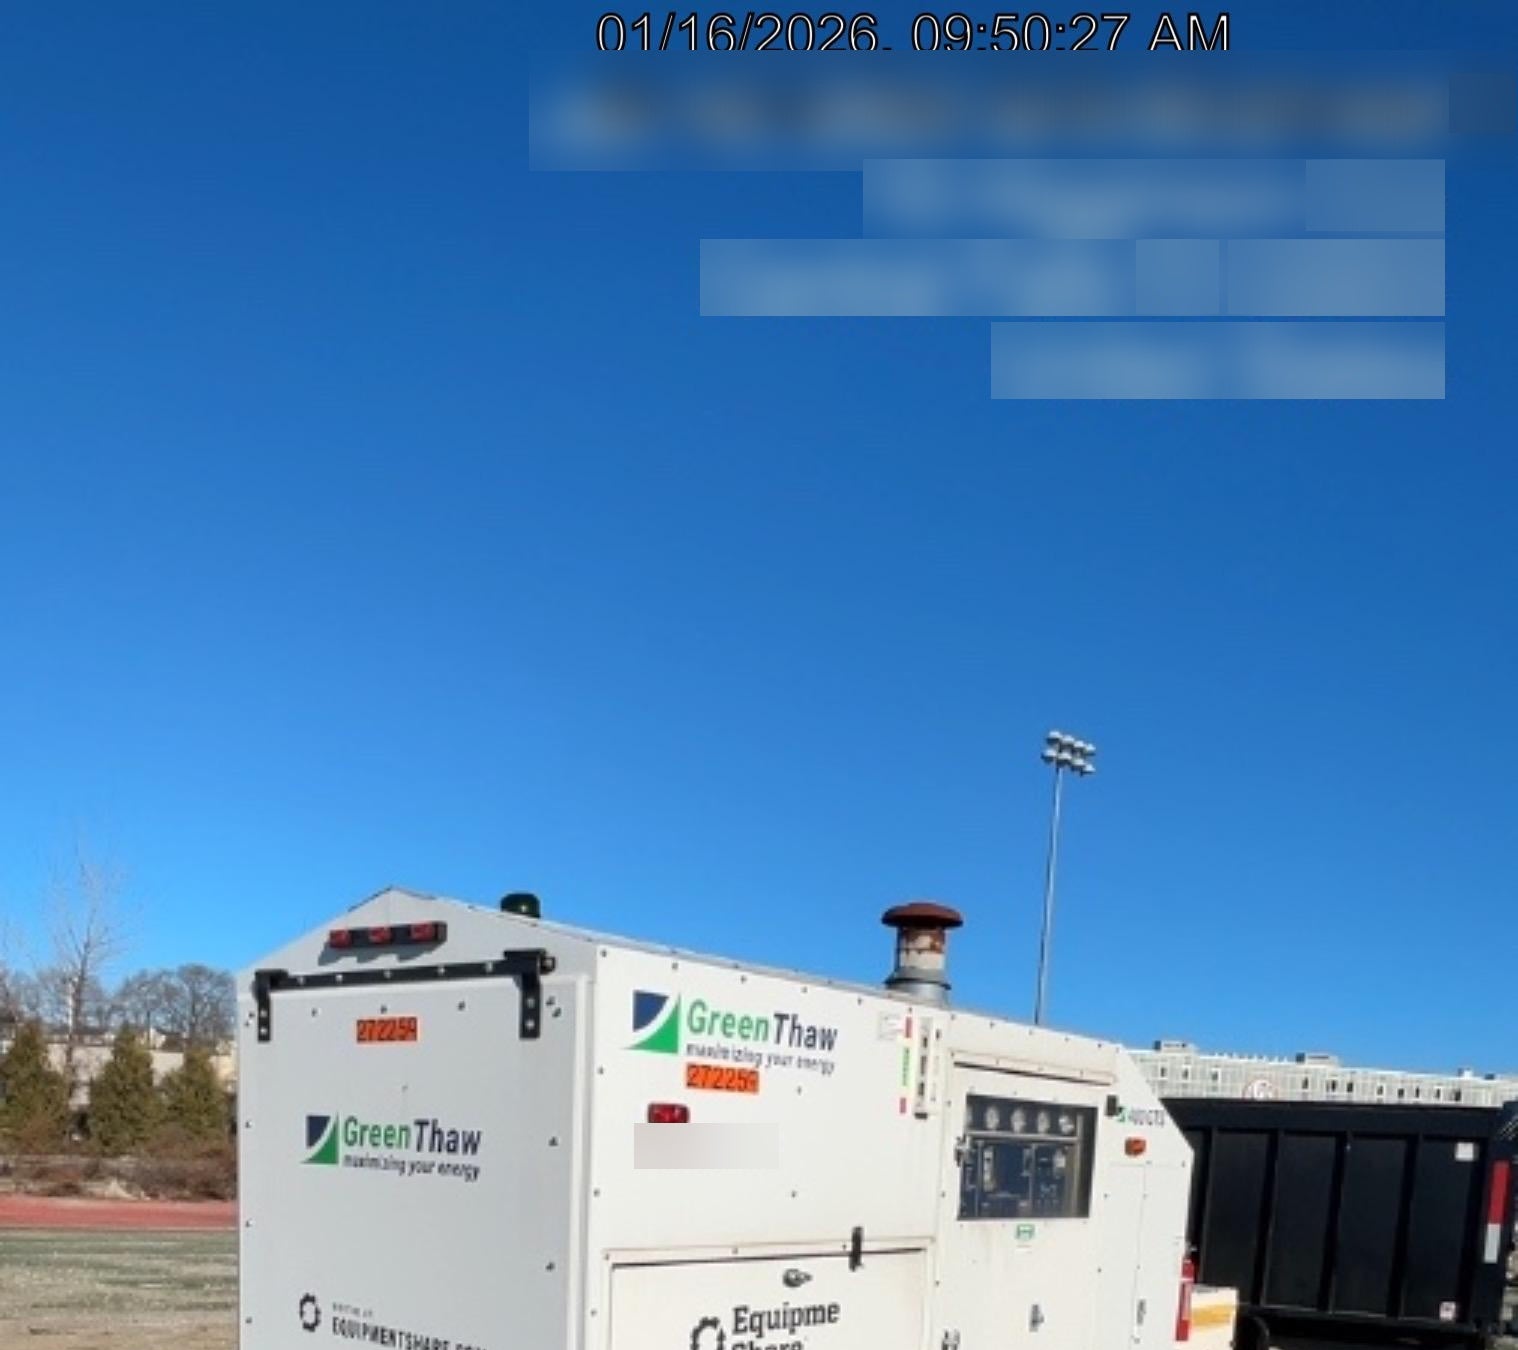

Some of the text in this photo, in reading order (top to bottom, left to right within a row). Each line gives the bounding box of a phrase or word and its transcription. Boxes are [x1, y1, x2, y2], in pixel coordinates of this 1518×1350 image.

[686, 999, 838, 1051] GreenThaw
[686, 1043, 835, 1076] maximizing your energy
[344, 1115, 482, 1155] GreenThaw
[344, 1153, 480, 1182] maximizing your energy
[732, 1301, 840, 1339] Equipme
